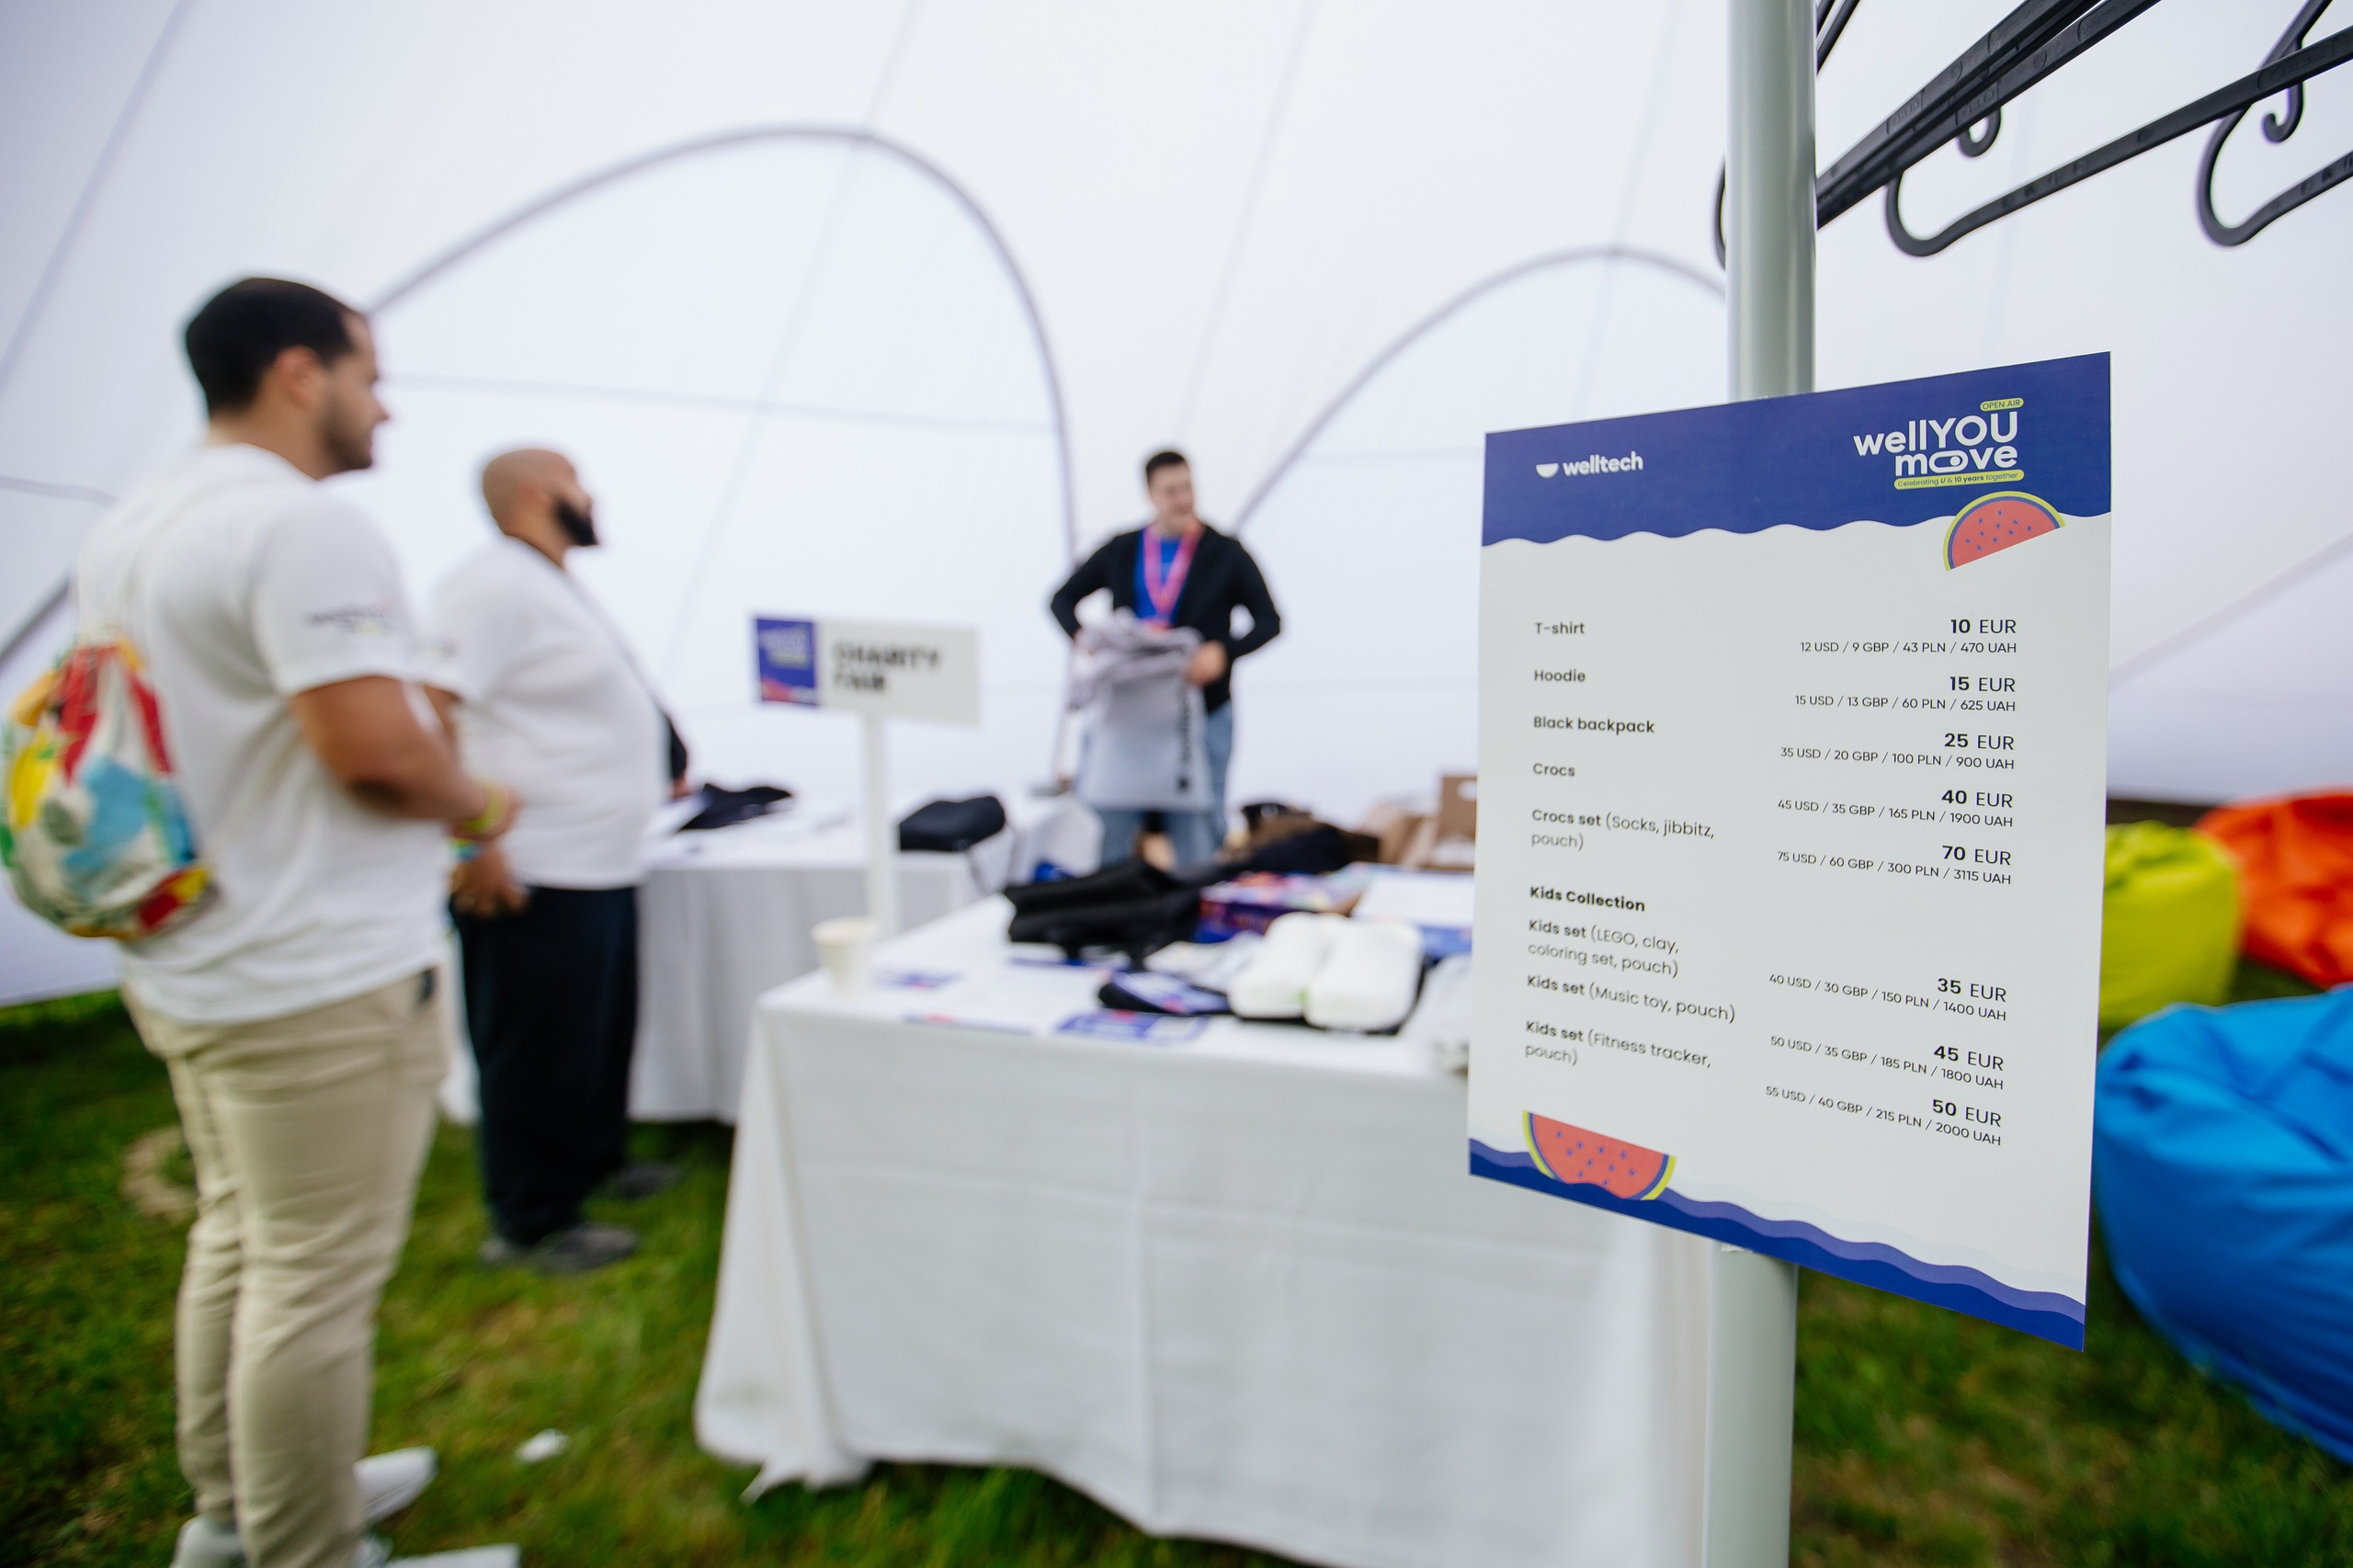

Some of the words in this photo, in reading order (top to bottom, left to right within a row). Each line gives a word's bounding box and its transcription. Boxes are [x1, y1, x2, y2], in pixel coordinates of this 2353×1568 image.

[1853, 412, 2018, 456] wellYOU
[1563, 450, 1643, 476] welltech
[1898, 478, 1938, 486] Celebrating
[1986, 472, 2018, 481] together
[1535, 621, 1585, 634] T-shirt
[1950, 619, 1971, 633] 10
[1980, 619, 2016, 633] EUR
[1801, 642, 1811, 652] 12
[1814, 642, 1839, 652] USD
[1852, 642, 1859, 652] 9
[1863, 642, 1889, 652] GBP
[1903, 642, 1918, 653] 43
[1922, 642, 1946, 653] PLN
[1961, 642, 1984, 653] 470
[1988, 642, 2017, 653] UAH
[1534, 669, 1586, 682] Hoodie
[1950, 676, 1970, 691] 15
[1979, 677, 2015, 692] EUR
[1795, 695, 1806, 705] 15
[1810, 696, 1834, 706] USD
[1847, 697, 1859, 707] 13
[1862, 697, 1888, 708] GBP
[1903, 699, 1917, 709] 60
[1922, 699, 1945, 710] PLN
[1961, 699, 1983, 710] 625
[1987, 700, 2015, 711] UAH
[1534, 716, 1574, 729] Black
[1578, 718, 1654, 735] backpack
[1944, 733, 1968, 748] 25
[1978, 734, 2014, 750] EUR
[1533, 763, 1574, 777] Crocs
[1781, 747, 1793, 757] 35
[1797, 748, 1821, 758] USD
[1835, 750, 1848, 760] 20
[1852, 751, 1878, 762] GBP
[1892, 754, 1914, 764] 100
[1918, 755, 1941, 766] PLN
[1956, 756, 1982, 767] 900
[1986, 758, 2014, 769] UAH
[1941, 790, 1967, 804] 40
[1976, 792, 2013, 808] EUR
[1532, 810, 1574, 824] Crocs
[1579, 815, 1601, 826] set
[1606, 812, 1659, 834] (Socks,
[1663, 819, 1713, 839] jibbitz,
[1778, 800, 1791, 810] 45
[1795, 801, 1819, 812] USD
[1832, 803, 1846, 813] 35
[1849, 805, 1875, 816] GBP
[1889, 808, 1907, 819] 165
[1912, 810, 1935, 821] PLN
[1949, 812, 1980, 824] 1900
[1984, 815, 2012, 827] UAH
[1532, 834, 1583, 850] pouch)
[1778, 851, 1789, 861] 75
[1792, 853, 1816, 864] USD
[1829, 857, 1844, 867] 60
[1847, 858, 1873, 869] GBP
[1888, 862, 1911, 874] 300
[1915, 865, 1938, 877] PLN
[1954, 869, 1979, 881] 3115
[1983, 872, 2010, 884] UAH
[1942, 845, 1966, 860] 70
[1975, 848, 2011, 866] EUR
[1530, 886, 1563, 901] Kids
[1565, 891, 1644, 912] Collection
[1529, 920, 1560, 935] Kids
[1564, 926, 1586, 938] set
[1591, 925, 1638, 948] (LEGO,
[1643, 936, 1678, 955] clay,
[1529, 945, 1587, 966] coloring
[1592, 954, 1617, 969] set,
[1622, 959, 1677, 978] pouch)
[1528, 975, 1558, 991] Kids
[1563, 983, 1585, 995] set
[1589, 982, 1639, 1005] (Music
[1643, 994, 1671, 1013] toy,
[1677, 1002, 1734, 1024] pouch)
[1769, 974, 1784, 984] 40
[1788, 976, 1812, 988] USD
[1824, 982, 1839, 993] 30
[1842, 985, 1868, 997] GBP
[1881, 992, 1902, 1003] 150
[1905, 995, 1928, 1008] PLN
[1943, 1002, 1974, 1016] 1400
[1978, 1006, 2006, 1021] UAH
[1938, 978, 1961, 994] 35
[1971, 983, 2006, 1003] EUR
[1526, 1021, 1557, 1037] Kids
[1561, 1029, 1583, 1042] set
[1588, 1029, 1646, 1054] (Fitness
[1651, 1044, 1711, 1068] tracker,
[1526, 1046, 1577, 1066] pouch)
[1771, 1036, 1785, 1047] 50
[1788, 1040, 1812, 1051] USD
[1824, 1046, 1838, 1057] 35
[1841, 1050, 1867, 1062] GBP
[1881, 1056, 1900, 1069] 185
[1904, 1061, 1927, 1074] PLN
[1941, 1068, 1972, 1083] 1800
[1976, 1074, 2003, 1090] UAH
[1934, 1046, 1959, 1062] 45
[1968, 1051, 2004, 1071] EUR
[1766, 1086, 1779, 1096] 55
[1782, 1089, 1805, 1102] USD
[1818, 1096, 1834, 1108] 40
[1836, 1101, 1862, 1113] GBP
[1876, 1109, 1894, 1121] 215
[1898, 1114, 1921, 1128] PLN
[1936, 1122, 1969, 1138] 2000
[1973, 1131, 2001, 1145] UAH
[1933, 1099, 1957, 1117] 50
[1965, 1107, 2001, 1127] EUR
